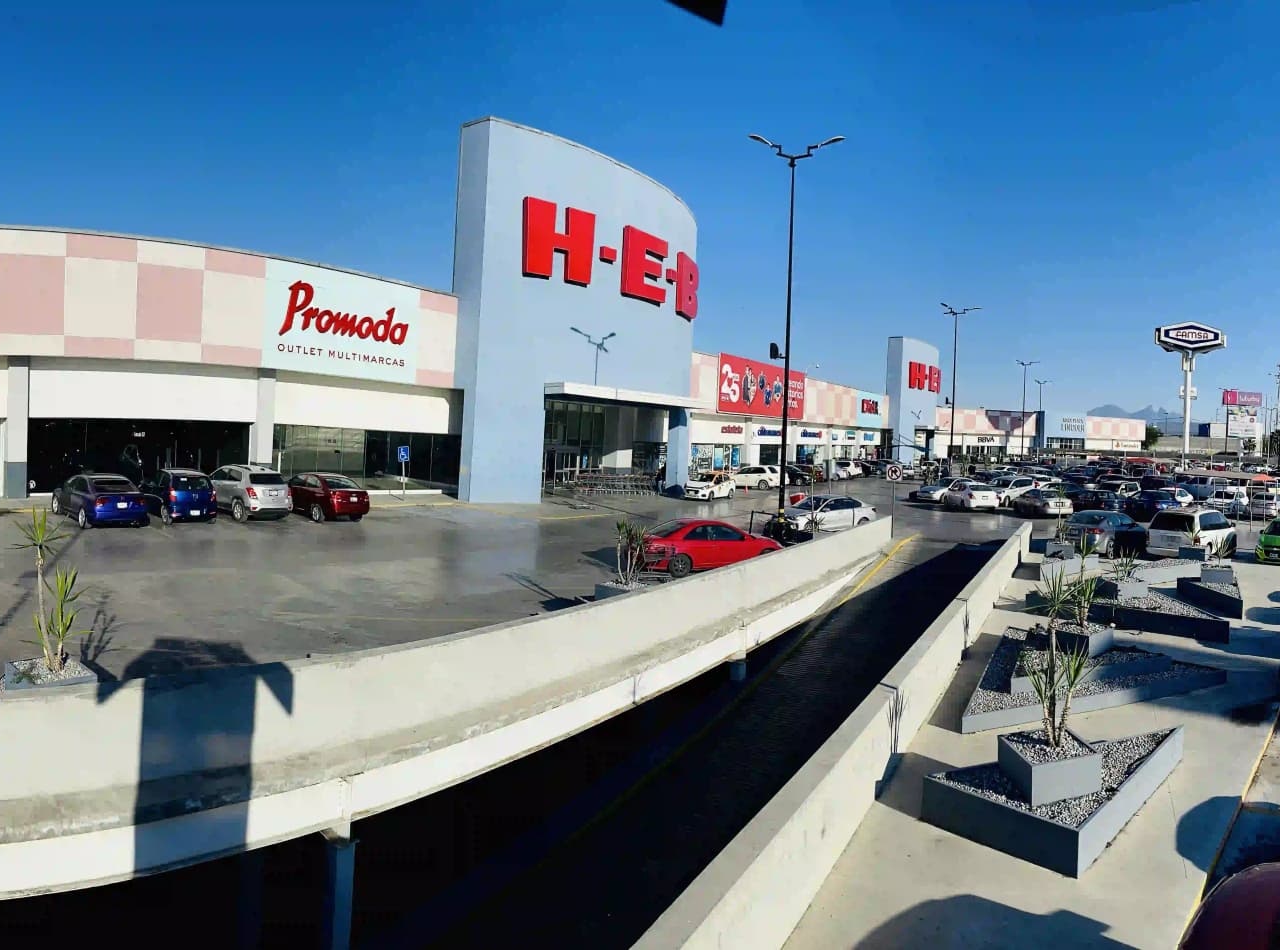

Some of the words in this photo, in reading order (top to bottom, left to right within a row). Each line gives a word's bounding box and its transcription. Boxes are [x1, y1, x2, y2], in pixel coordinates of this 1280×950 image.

[522, 196, 699, 322] H-E-B
[278, 280, 409, 346] Promoda
[277, 343, 323, 357] OUTLET
[328, 350, 406, 367] MULTIMARCAS
